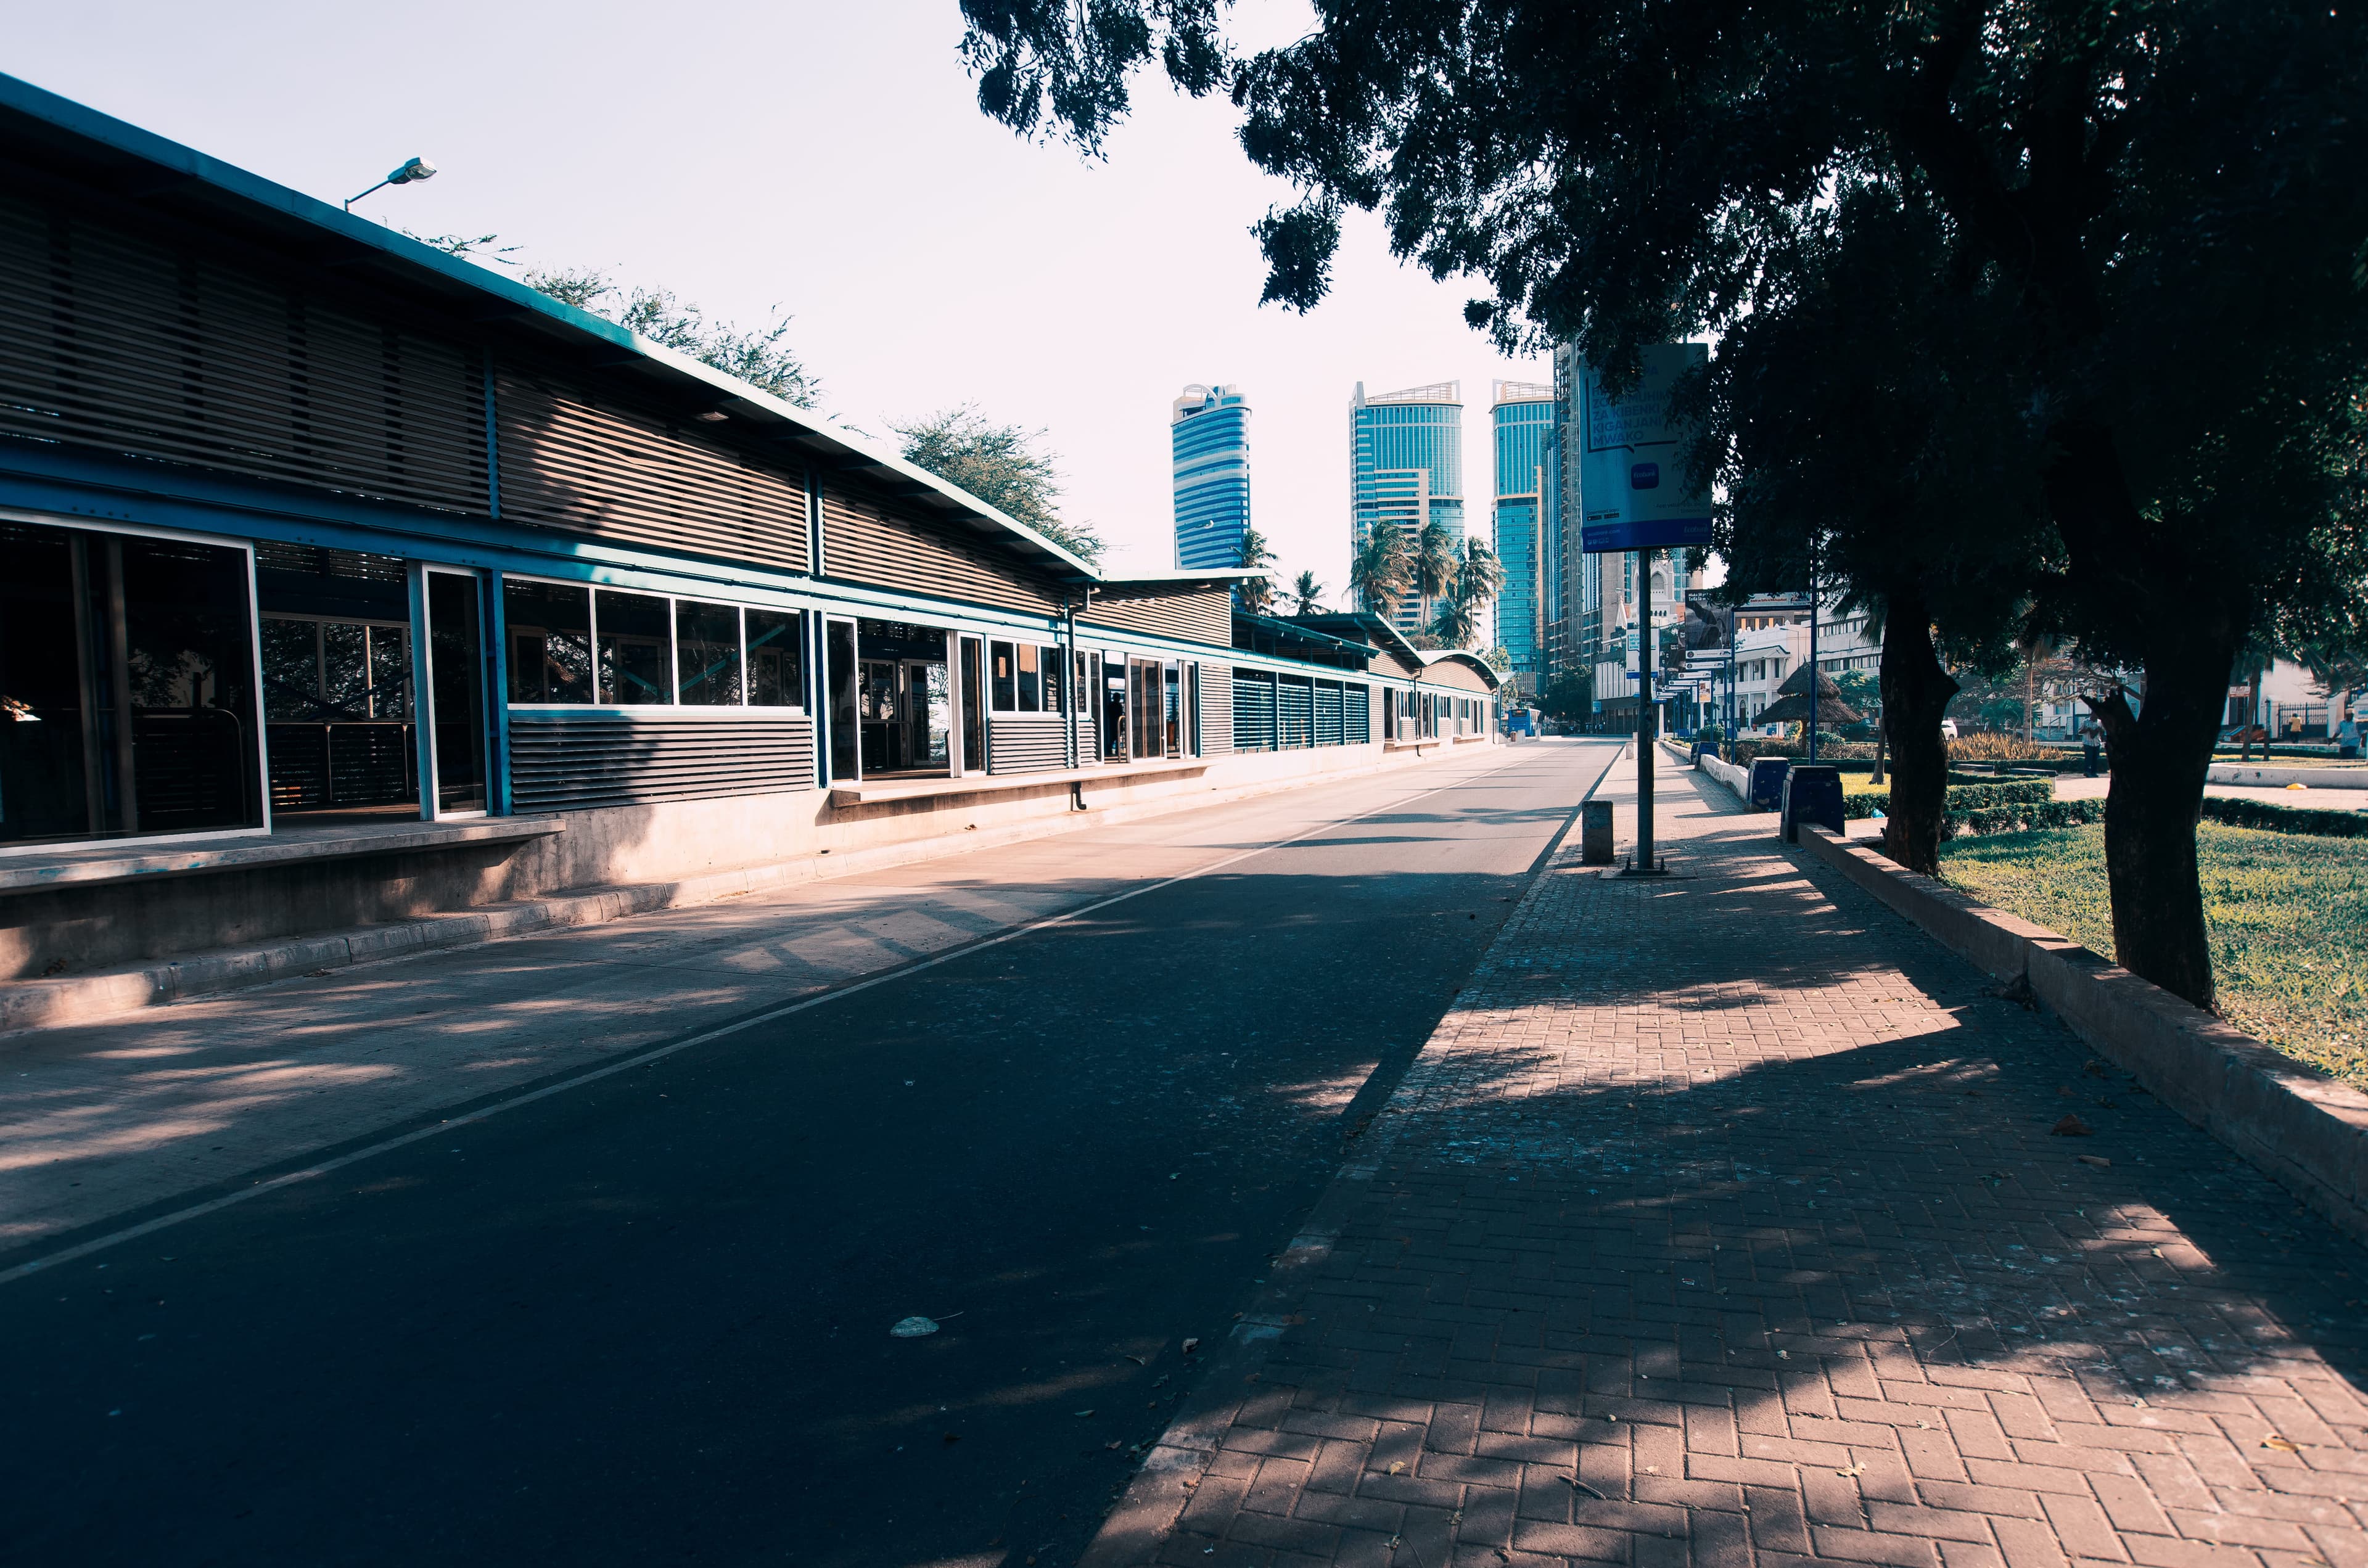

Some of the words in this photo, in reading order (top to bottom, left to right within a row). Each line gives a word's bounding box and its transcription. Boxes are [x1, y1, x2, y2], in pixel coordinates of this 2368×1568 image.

[1593, 410, 1608, 421] ZA
[1613, 404, 1660, 417] KIBENKI
[1593, 416, 1662, 433] KIGANJANI
[1593, 430, 1643, 446] MWAKO
